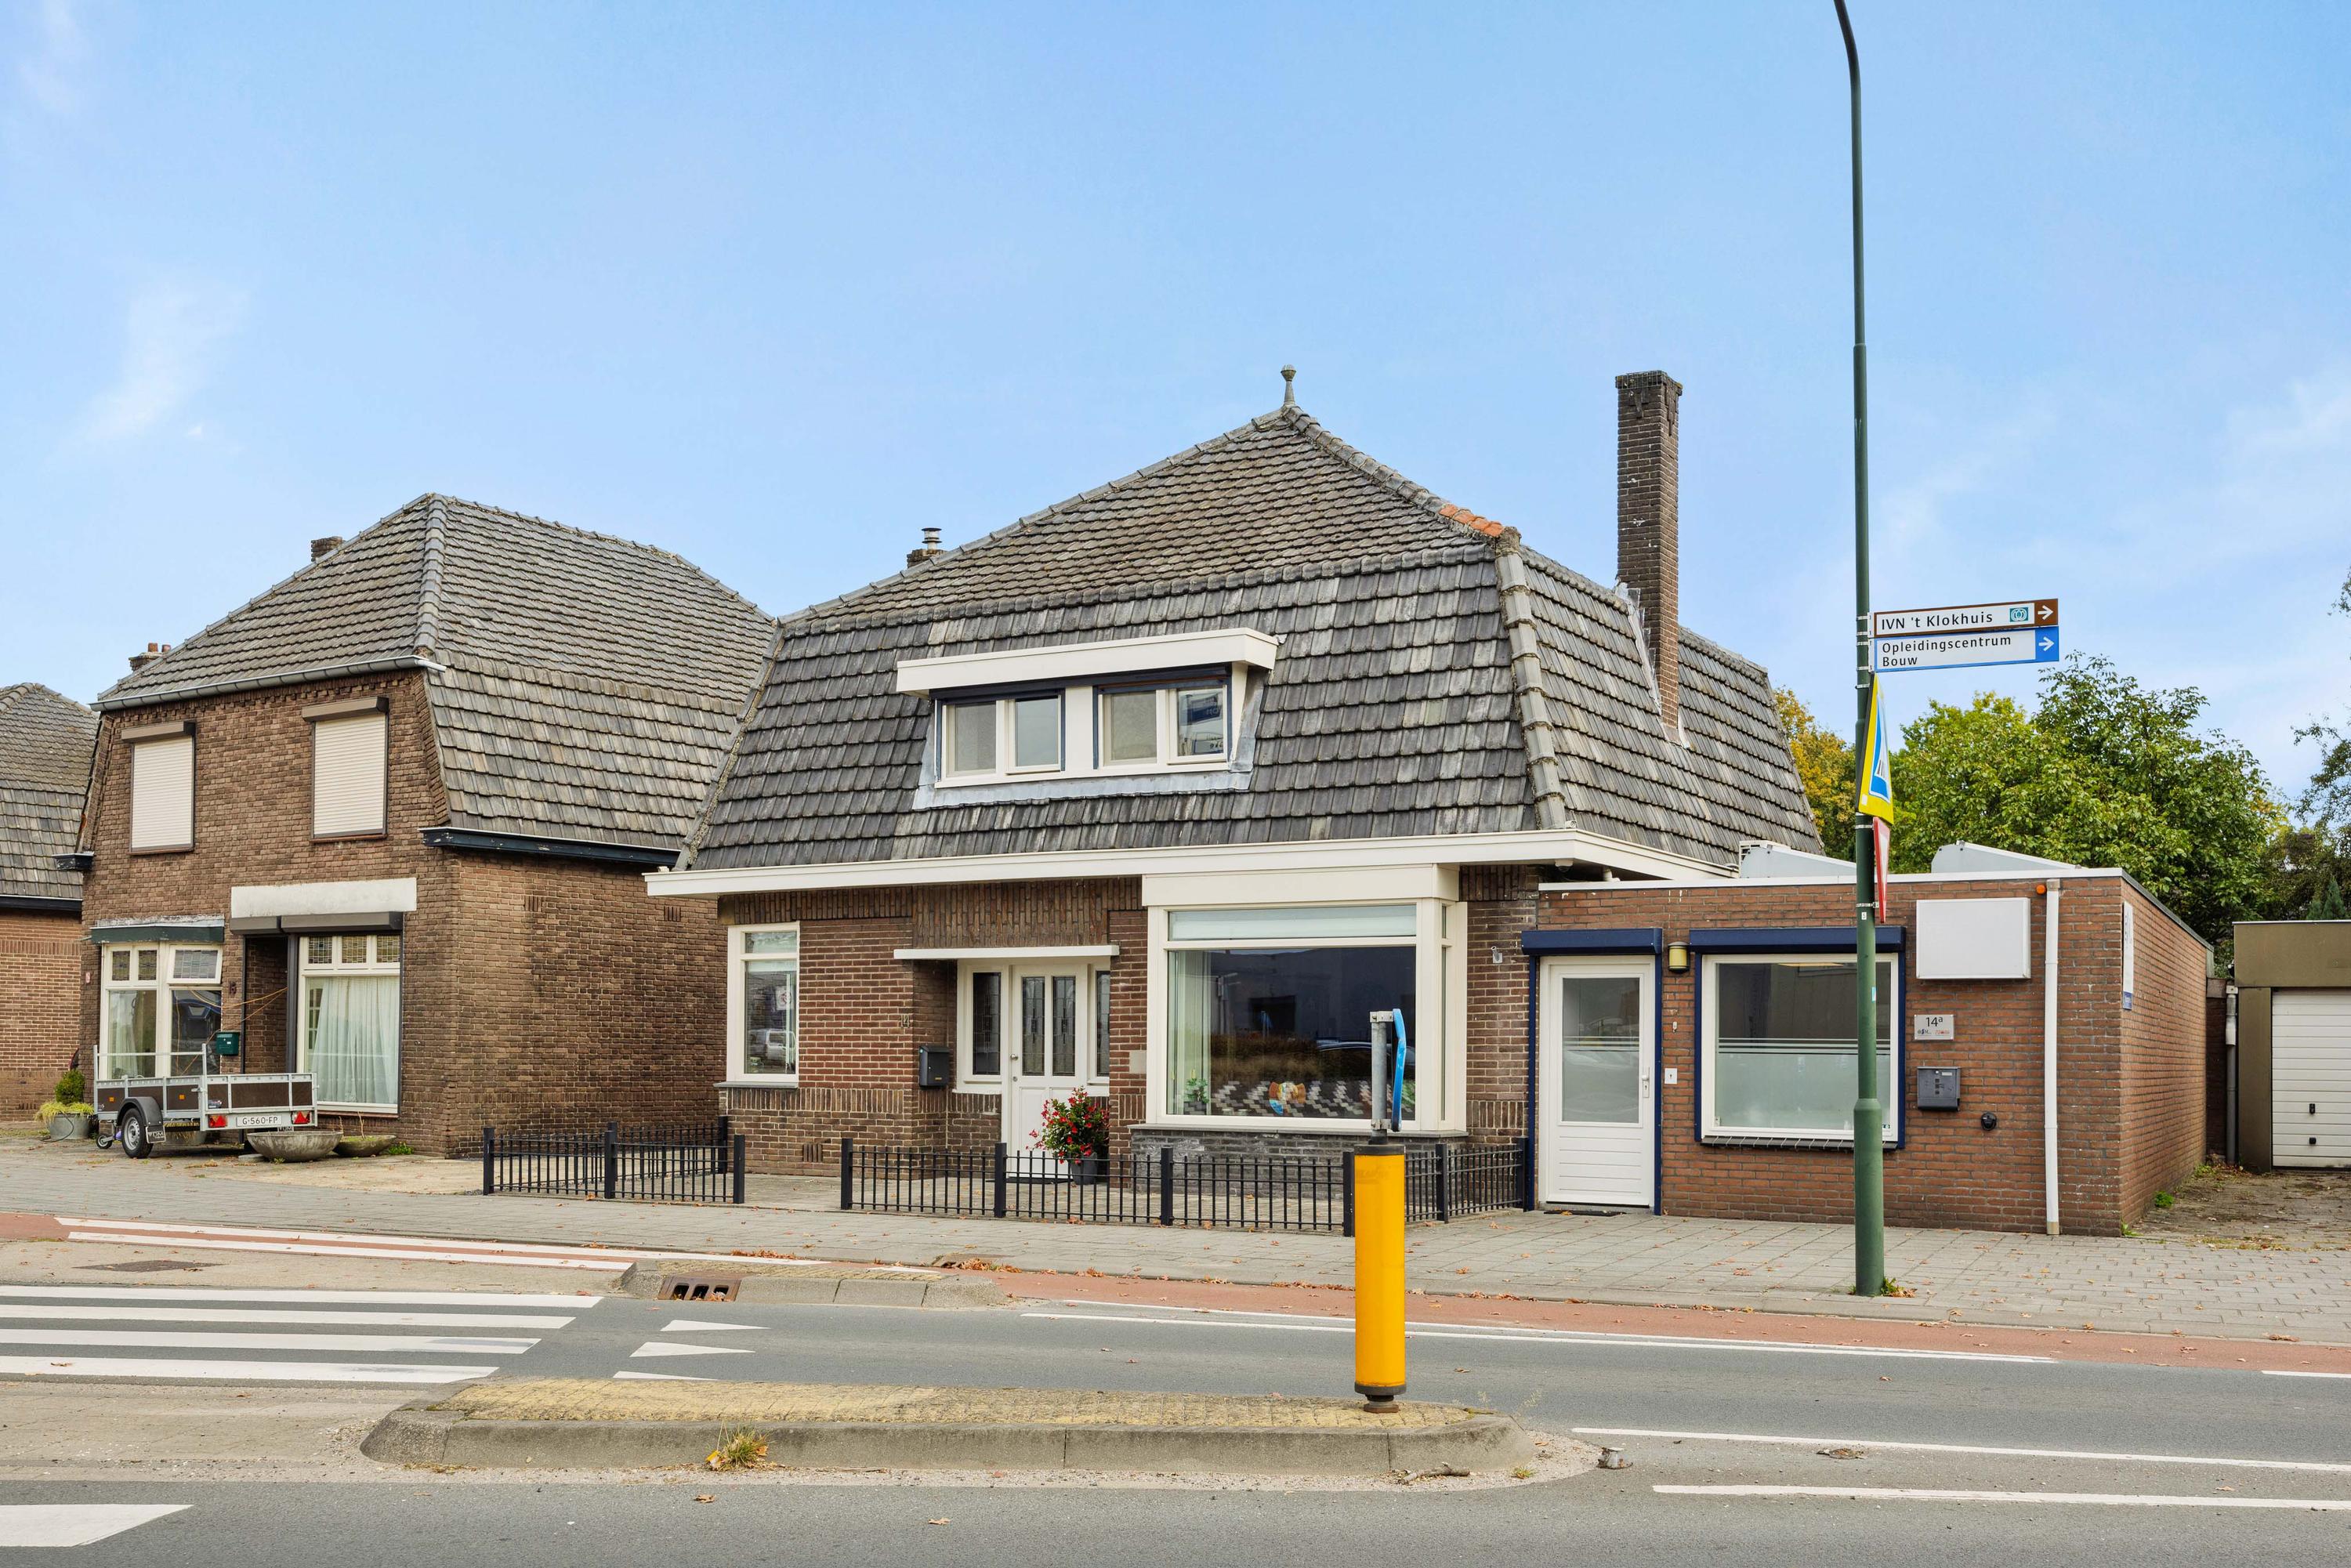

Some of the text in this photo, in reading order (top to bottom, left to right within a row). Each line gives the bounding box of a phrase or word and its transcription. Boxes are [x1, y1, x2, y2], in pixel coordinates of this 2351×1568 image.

[1882, 611, 1993, 630] IVN 't Klokhuis
[1882, 636, 2011, 654] Opleidingscentrum
[1882, 656, 1918, 667] Bouw
